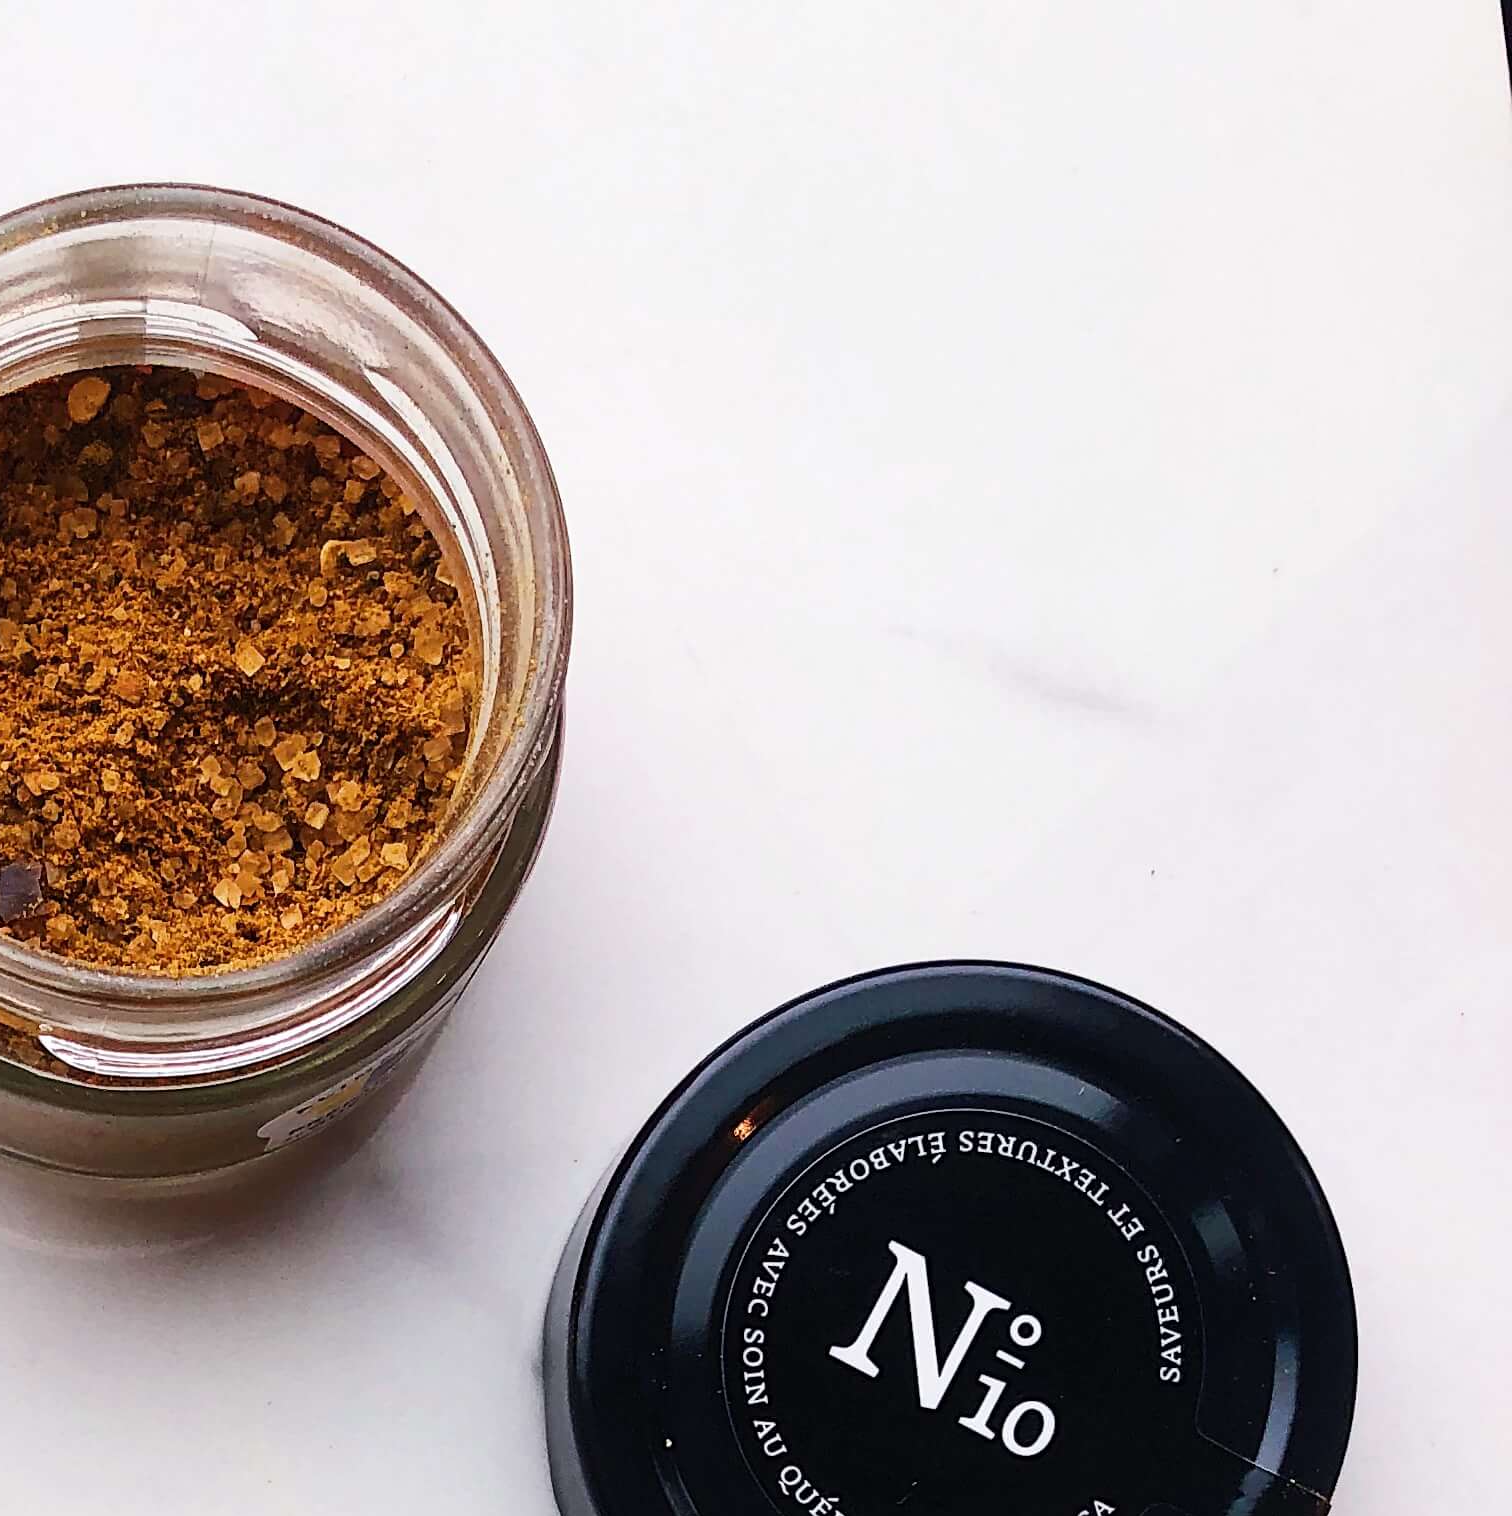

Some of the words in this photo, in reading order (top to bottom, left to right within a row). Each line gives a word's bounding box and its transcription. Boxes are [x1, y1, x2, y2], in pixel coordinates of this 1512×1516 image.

[786, 1131, 947, 1236] ÉLABORÉES
[959, 1130, 1110, 1207] TEXTURES
[1106, 1203, 1145, 1241] ET
[747, 1237, 790, 1317] AVEC
[1136, 1244, 1183, 1384] SAVEURS
[742, 1327, 769, 1405] SOIN
[753, 1420, 788, 1457] AU
[958, 1374, 1056, 1457] 10
